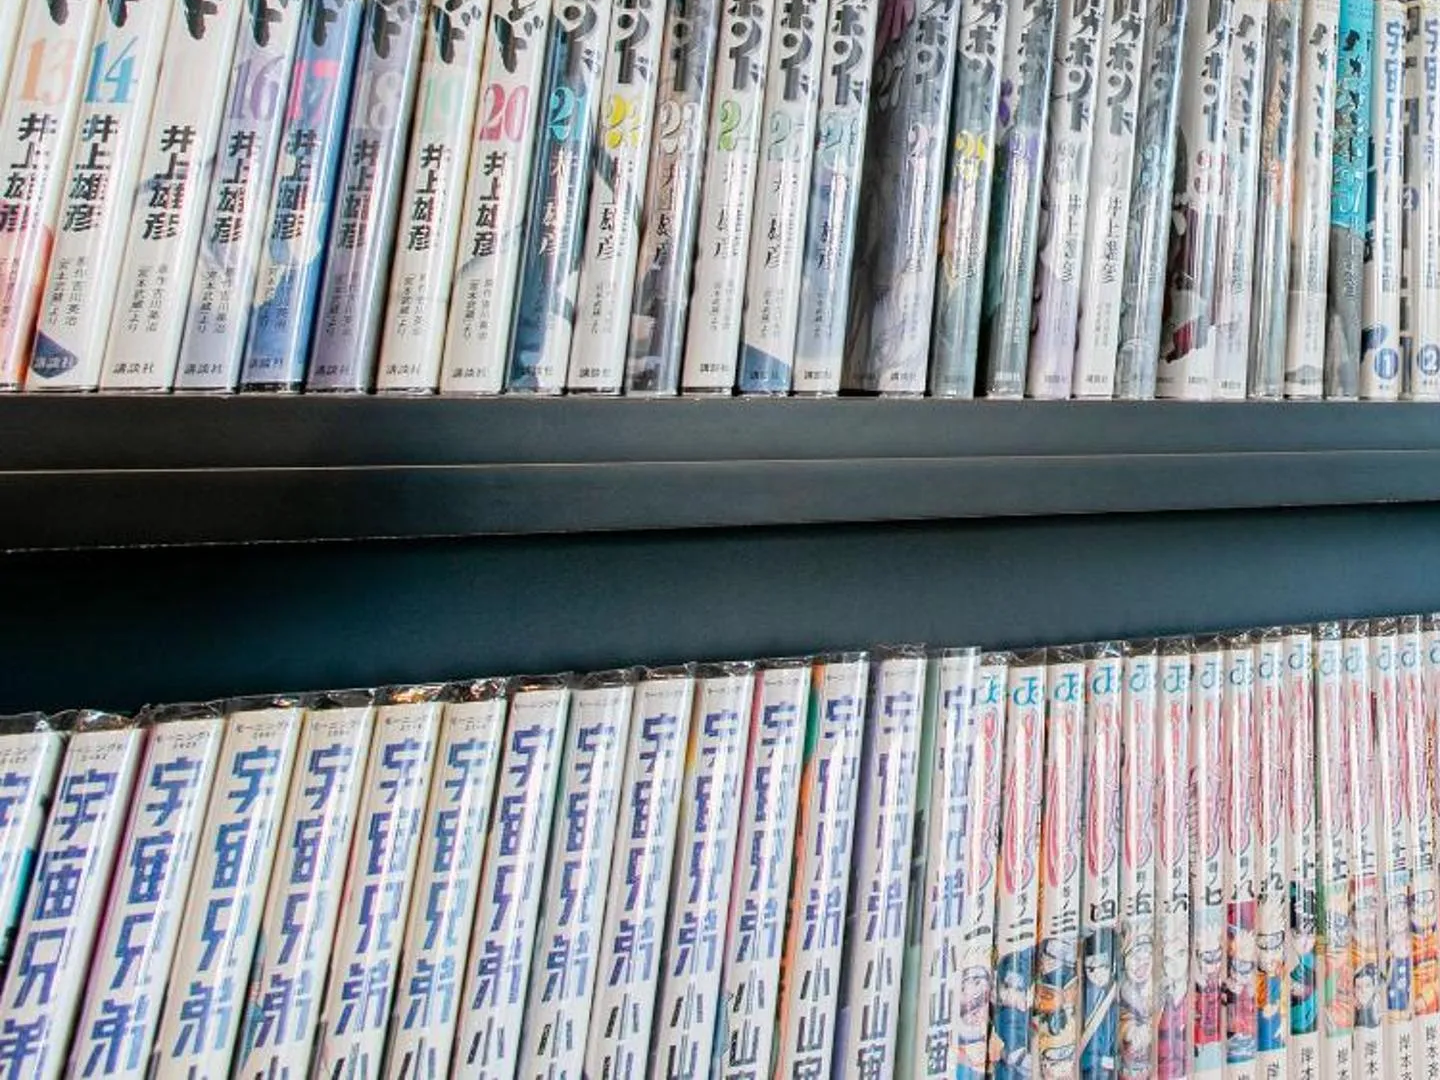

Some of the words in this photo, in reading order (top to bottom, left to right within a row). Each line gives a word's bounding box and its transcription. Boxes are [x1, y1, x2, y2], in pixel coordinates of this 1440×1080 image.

[84, 35, 138, 103] 14
[230, 56, 284, 120] 16
[287, 60, 338, 123] 17
[479, 83, 529, 142] 20
[549, 86, 589, 143] 21
[1, 113, 56, 232] 井上雄彦
[63, 114, 117, 232] 井上雄彦
[142, 124, 196, 240] 井上雄彦
[213, 130, 256, 243] 井上雄彦
[271, 128, 316, 240] 井上雄彦
[337, 139, 379, 249] 井上雄彦
[408, 143, 444, 251] 井上雄彦
[472, 150, 506, 257] 井上雄彦
[172, 746, 281, 1057] 宇宙兄弟
[255, 744, 352, 1048] 宇宙兄弟
[336, 738, 430, 1035] 宇宙兄弟
[403, 738, 492, 1030] 宇宙兄弟
[472, 725, 553, 1009] 宇宙兄弟
[542, 723, 615, 1003] 宇宙兄弟
[609, 714, 677, 986] 宇宙兄弟
[83, 757, 202, 1077] 宇宙兄弟
